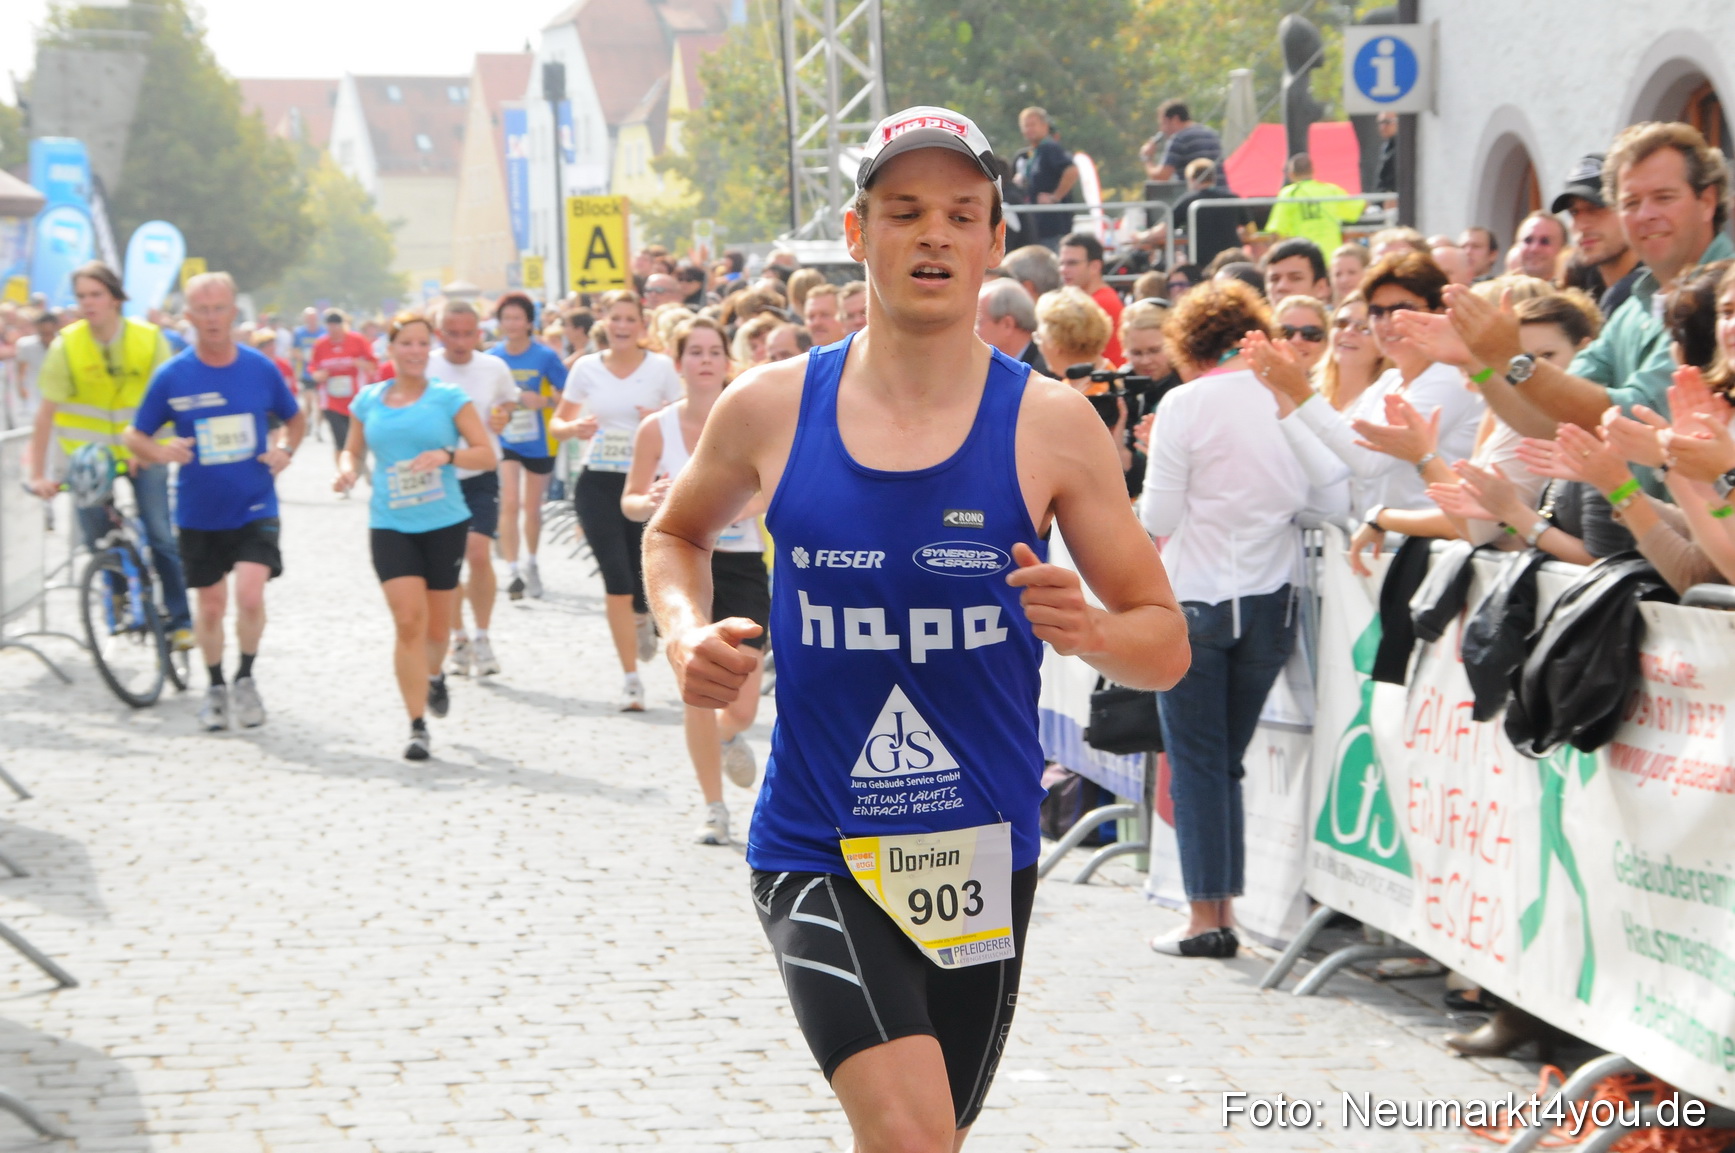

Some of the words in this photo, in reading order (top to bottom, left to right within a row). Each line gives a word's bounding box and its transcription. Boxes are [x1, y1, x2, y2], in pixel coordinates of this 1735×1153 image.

[573, 199, 622, 218] Block
[582, 224, 617, 270] A
[814, 549, 886, 569] FESER
[921, 548, 992, 560] SYNERGY
[942, 559, 996, 569] SPORTS
[797, 589, 1009, 664] hapa
[850, 779, 867, 789] Jura
[868, 777, 905, 789] Gebäude
[906, 775, 935, 787] Service
[936, 771, 961, 783] GmbH
[857, 793, 878, 805] MIT
[879, 792, 907, 805] UNS
[912, 797, 965, 814] BESSER.
[889, 847, 961, 873] Dorian
[907, 879, 984, 926] 903
[953, 937, 1012, 957] PFLEIDERER
